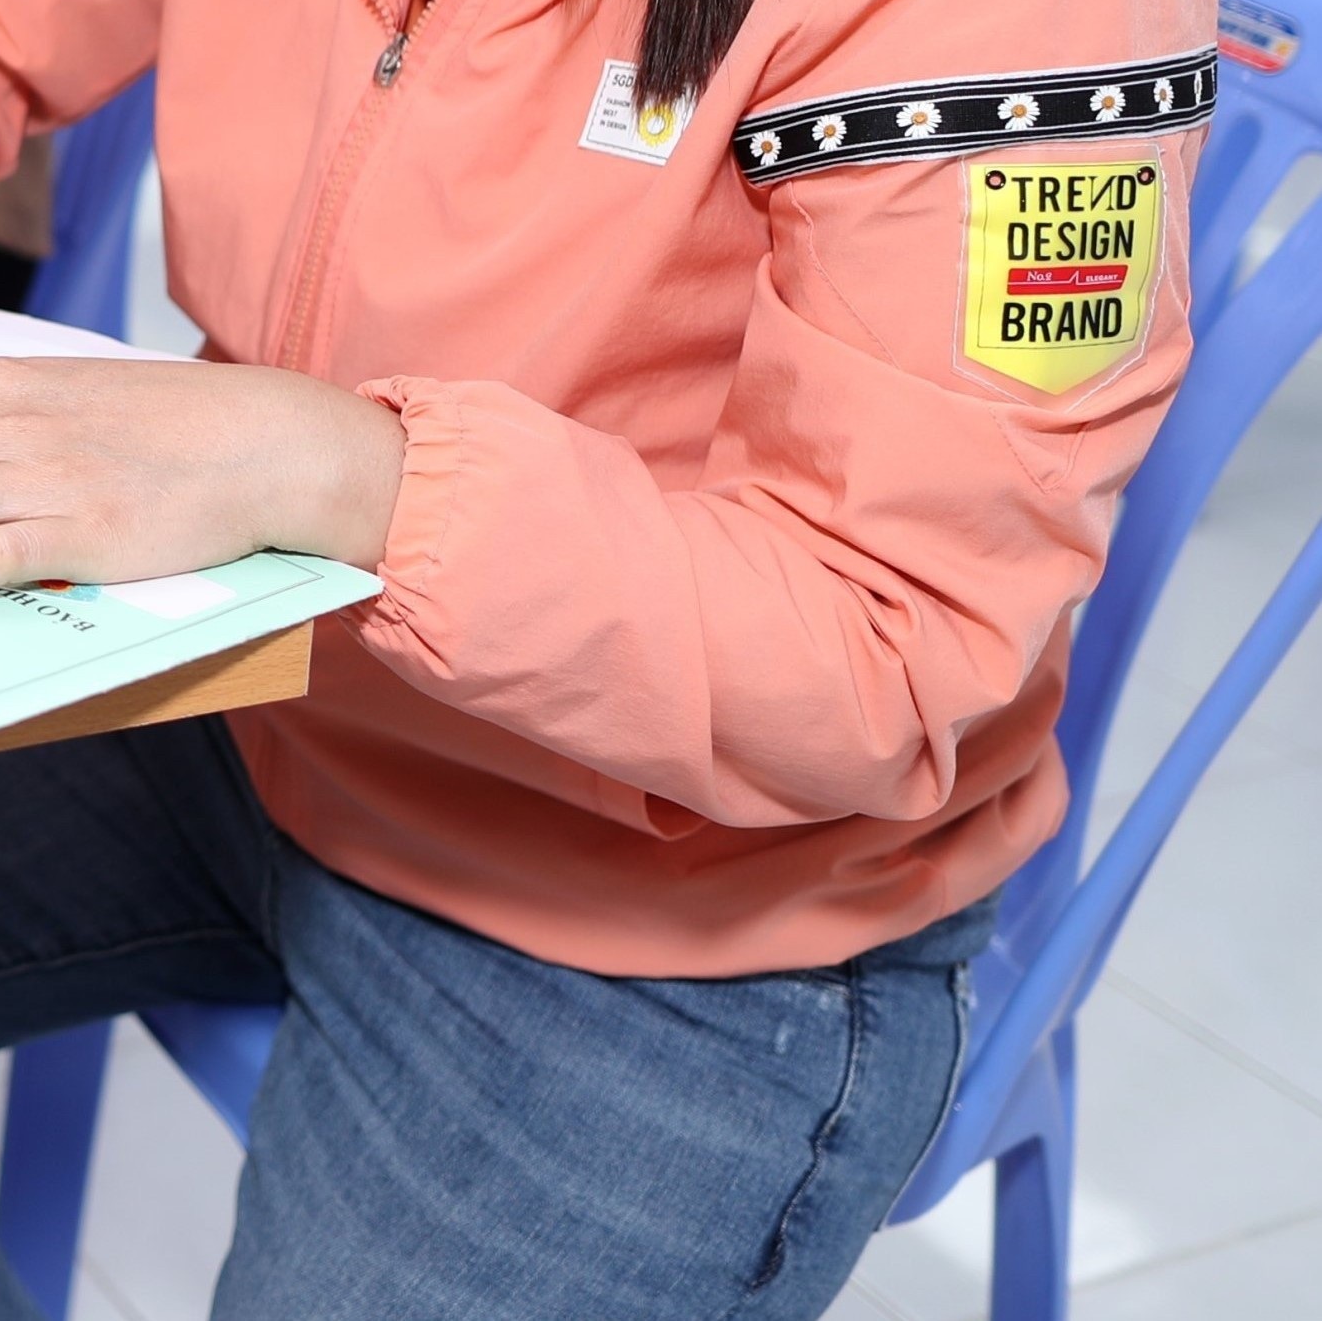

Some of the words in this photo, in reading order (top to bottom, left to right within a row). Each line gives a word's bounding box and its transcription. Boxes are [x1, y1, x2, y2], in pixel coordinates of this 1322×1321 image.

[606, 119, 627, 131] DESIGN
[1007, 219, 1135, 261] DESIGN
[1085, 273, 1119, 283] ELEGANT
[1000, 297, 1123, 343] BRAND
[32, 602, 96, 636] BẢO
